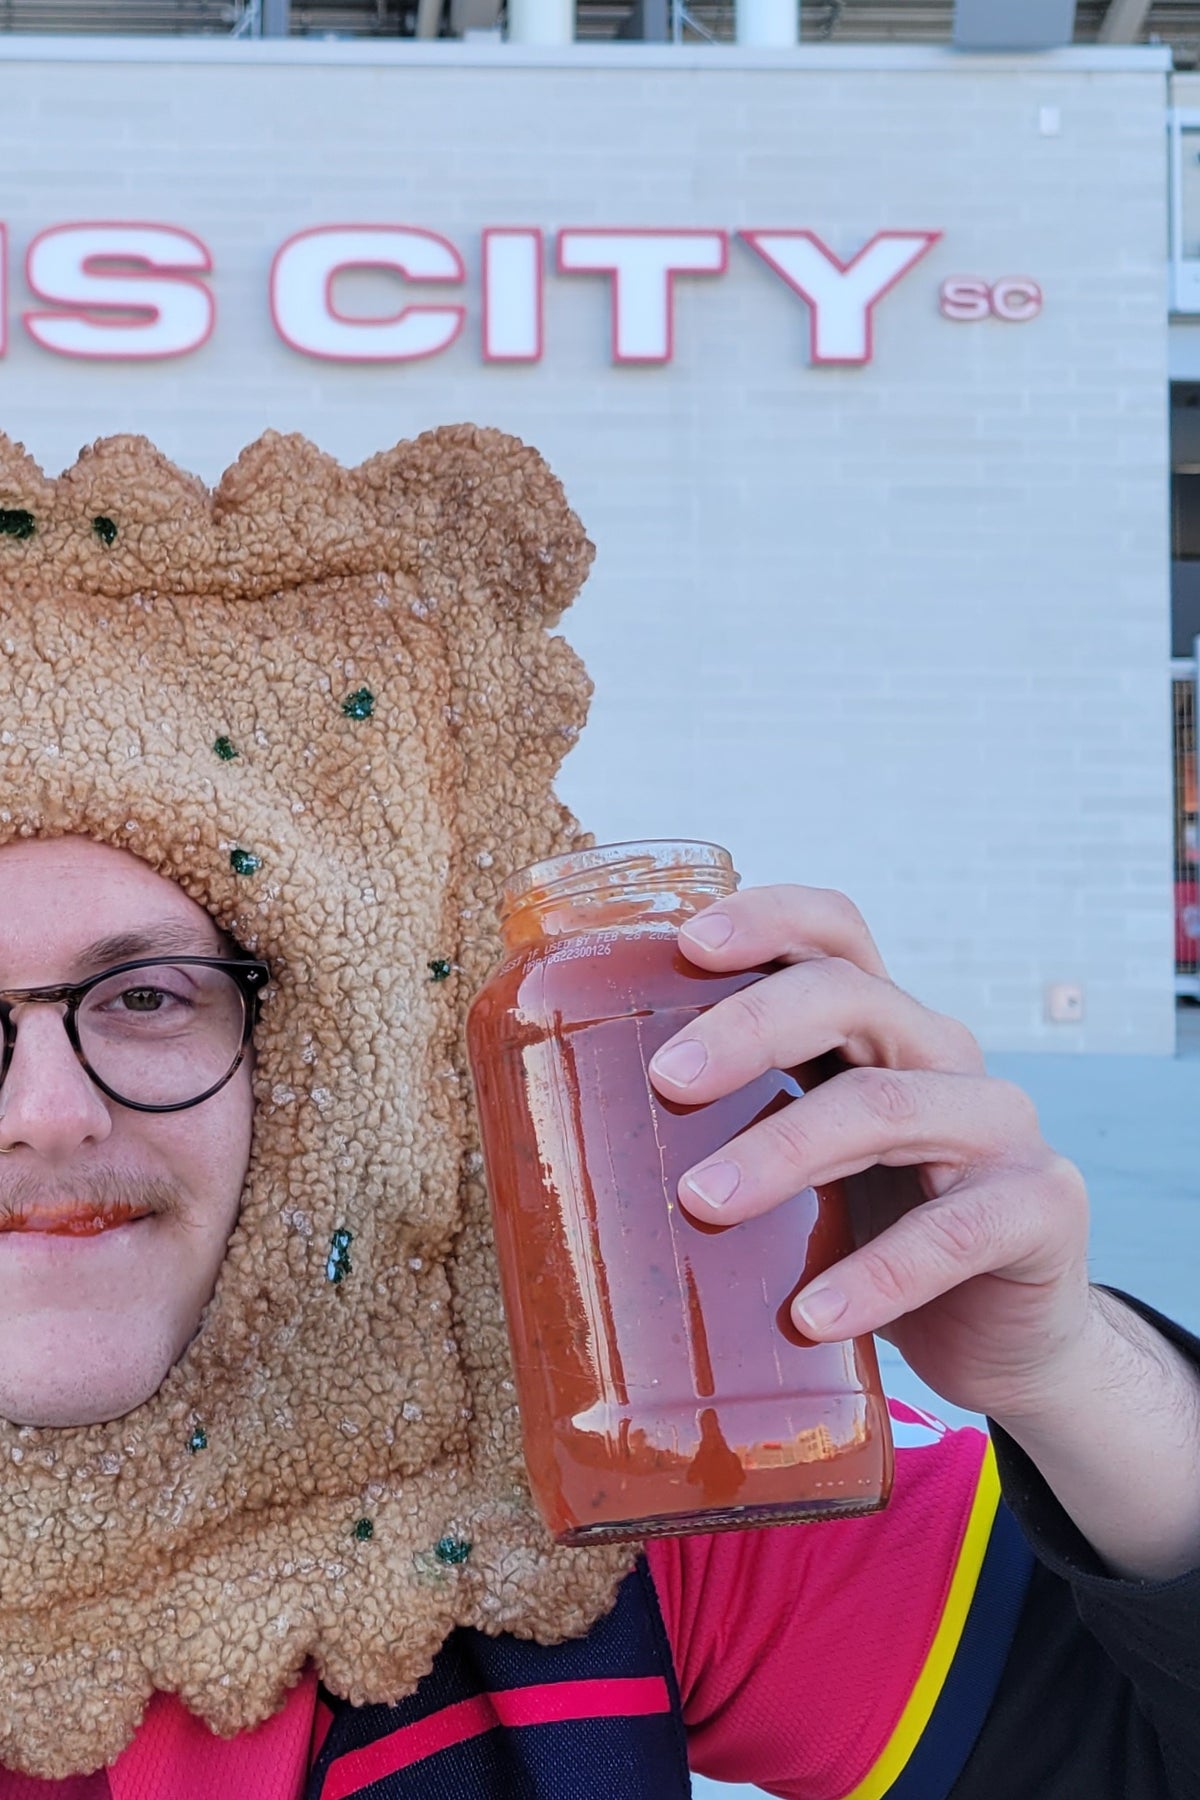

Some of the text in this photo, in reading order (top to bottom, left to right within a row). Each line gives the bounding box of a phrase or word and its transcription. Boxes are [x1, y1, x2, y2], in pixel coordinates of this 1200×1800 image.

[270, 225, 942, 365] CITY
[940, 275, 1043, 322] SC
[527, 948, 540, 962] IF
[544, 939, 571, 957] USED
[575, 934, 591, 948] BY
[597, 931, 619, 944] FEB
[624, 929, 641, 941] 28
